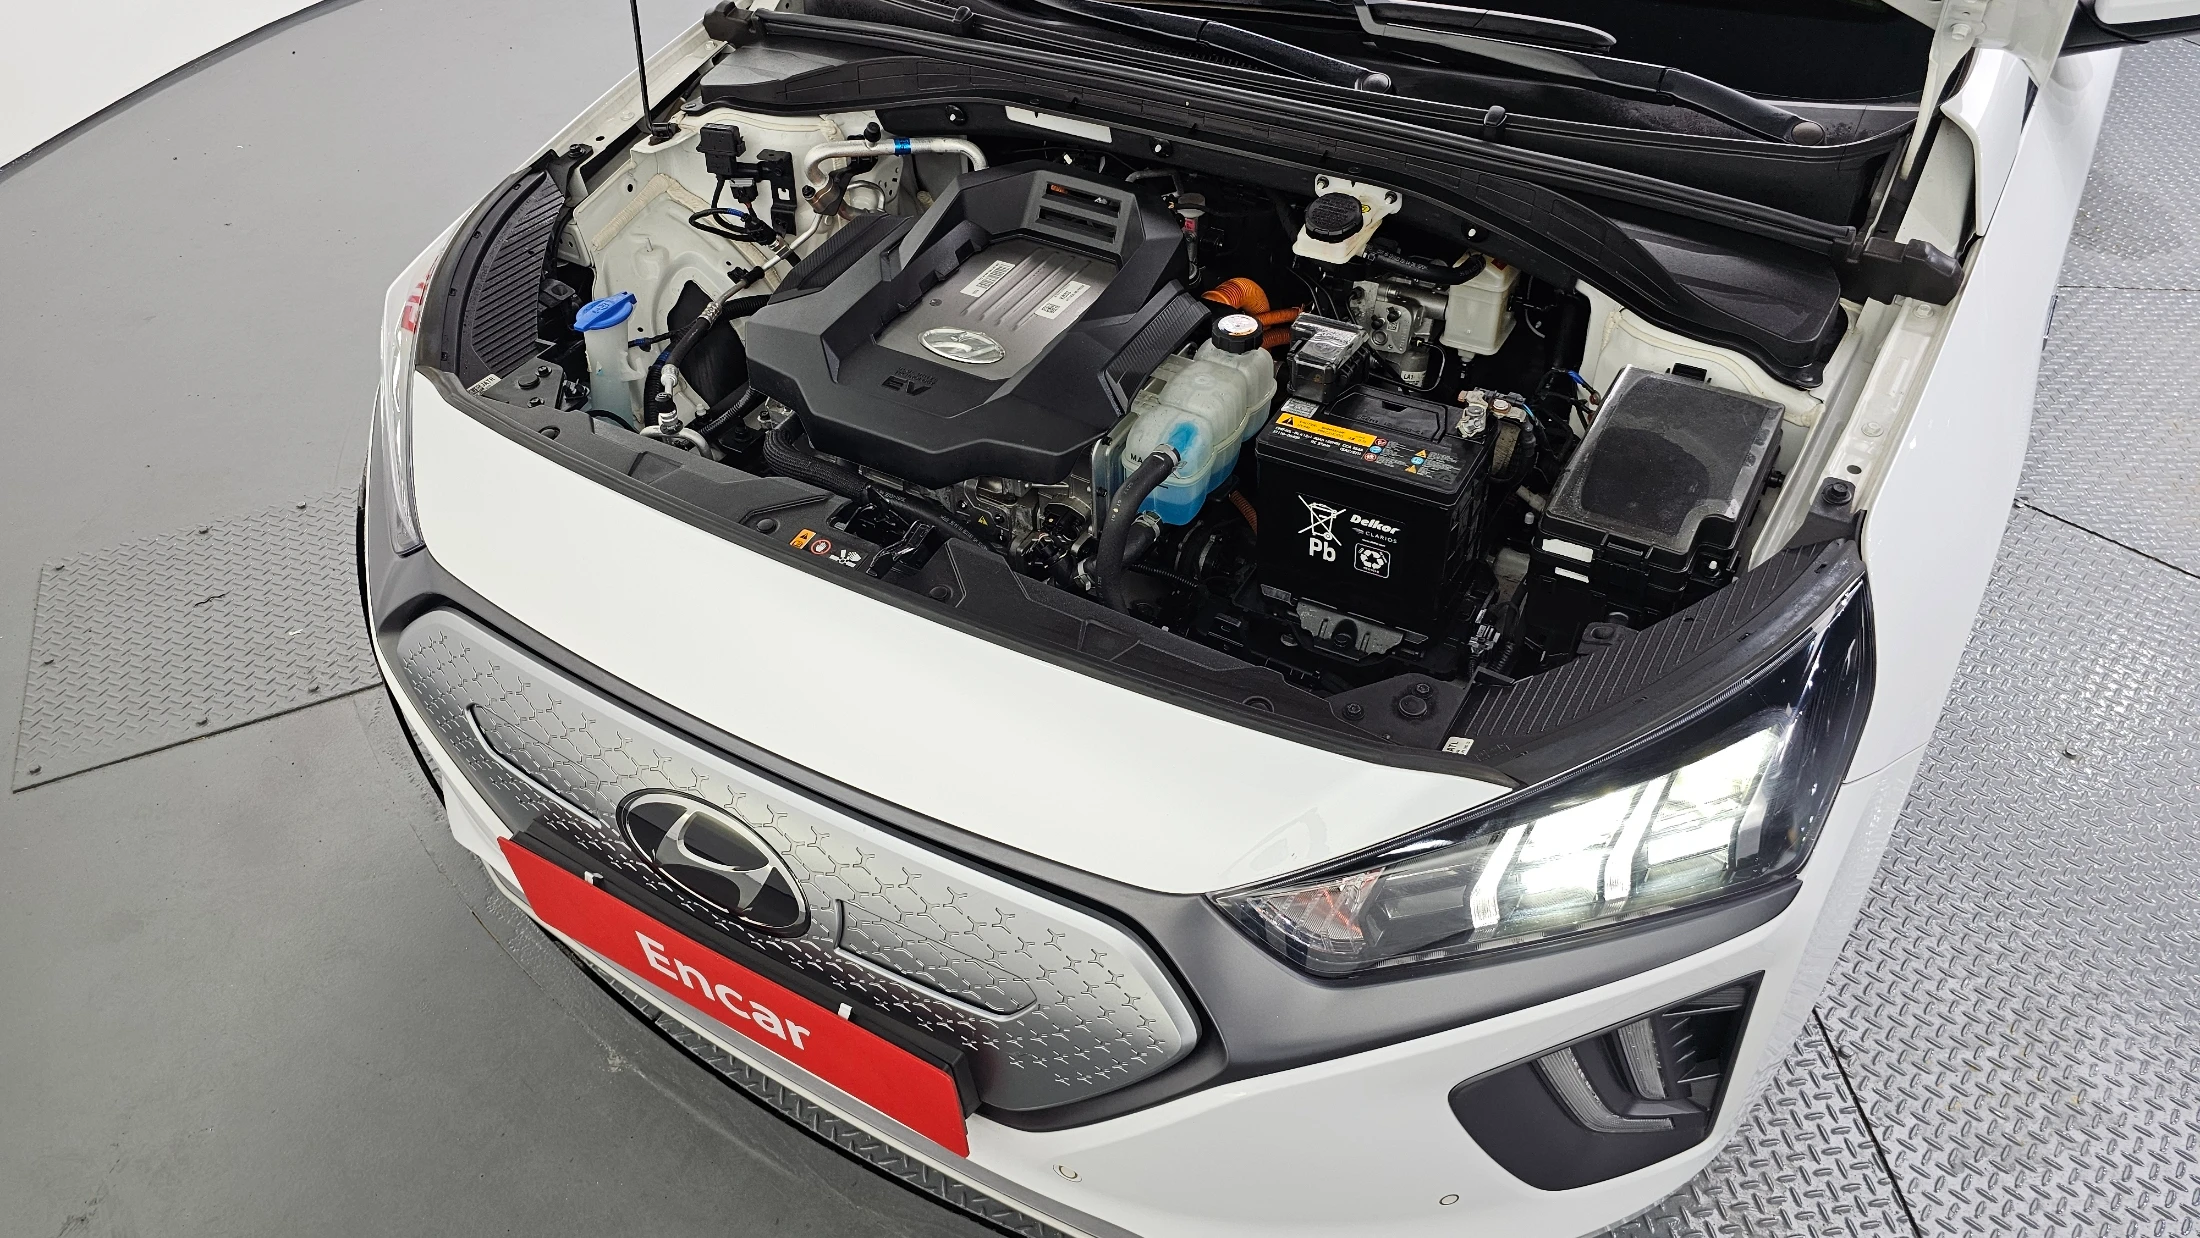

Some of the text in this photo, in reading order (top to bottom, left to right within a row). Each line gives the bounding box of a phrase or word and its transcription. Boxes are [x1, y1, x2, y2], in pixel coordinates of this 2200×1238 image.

[881, 375, 932, 396] EV
[1130, 453, 1143, 463] MA
[1350, 514, 1401, 535] Delkor
[1365, 531, 1398, 544] CLARIOS
[1309, 537, 1336, 562] Pb
[635, 930, 810, 1051] Encar
